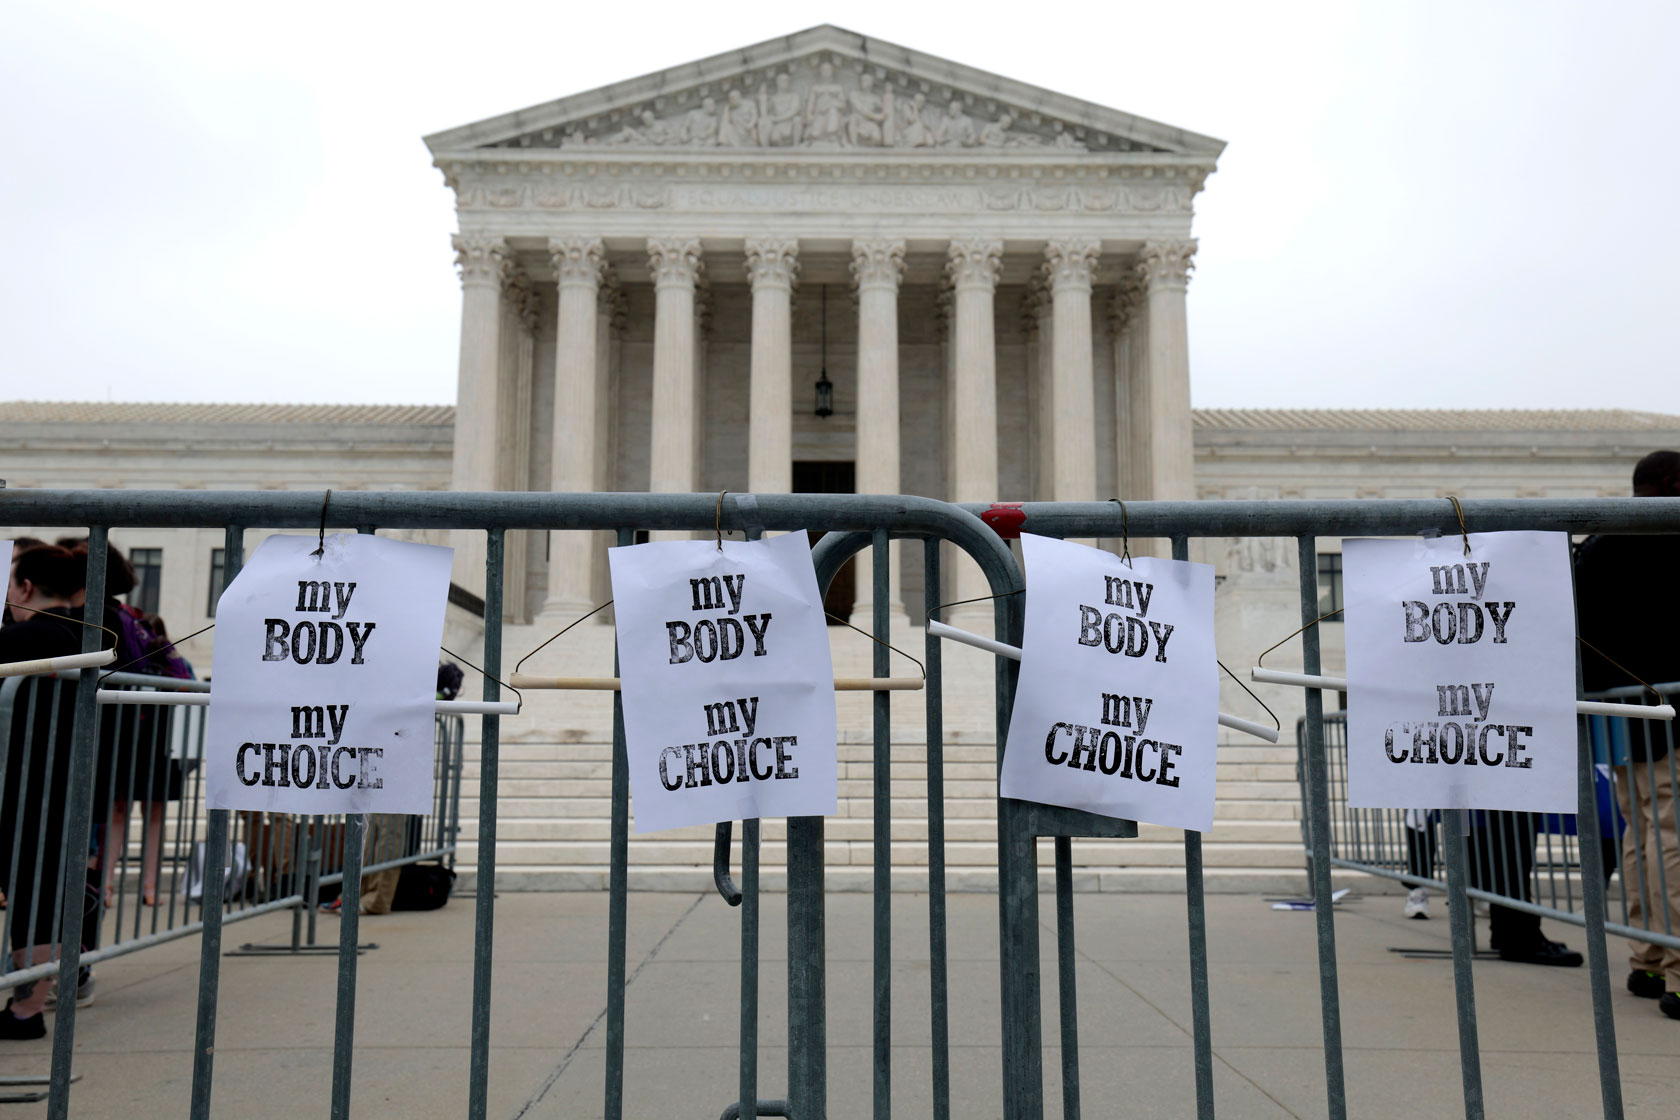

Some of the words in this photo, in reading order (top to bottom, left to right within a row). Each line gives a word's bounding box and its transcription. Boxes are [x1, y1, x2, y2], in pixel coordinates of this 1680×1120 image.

[295, 580, 357, 620] my
[690, 574, 745, 615] my
[1104, 575, 1154, 618] my
[1429, 562, 1490, 601] my
[262, 618, 376, 665] BODY
[665, 613, 772, 665] BODY
[1078, 604, 1174, 663] BODY
[1402, 600, 1516, 645] BODY
[291, 704, 349, 745] my
[703, 696, 759, 738] my
[1100, 692, 1153, 736] my
[1436, 683, 1495, 722] my
[236, 742, 384, 789] CHOICE
[658, 736, 799, 791] CHOICE
[1045, 722, 1183, 788] CHOICE
[1384, 721, 1533, 769] CHOICE
